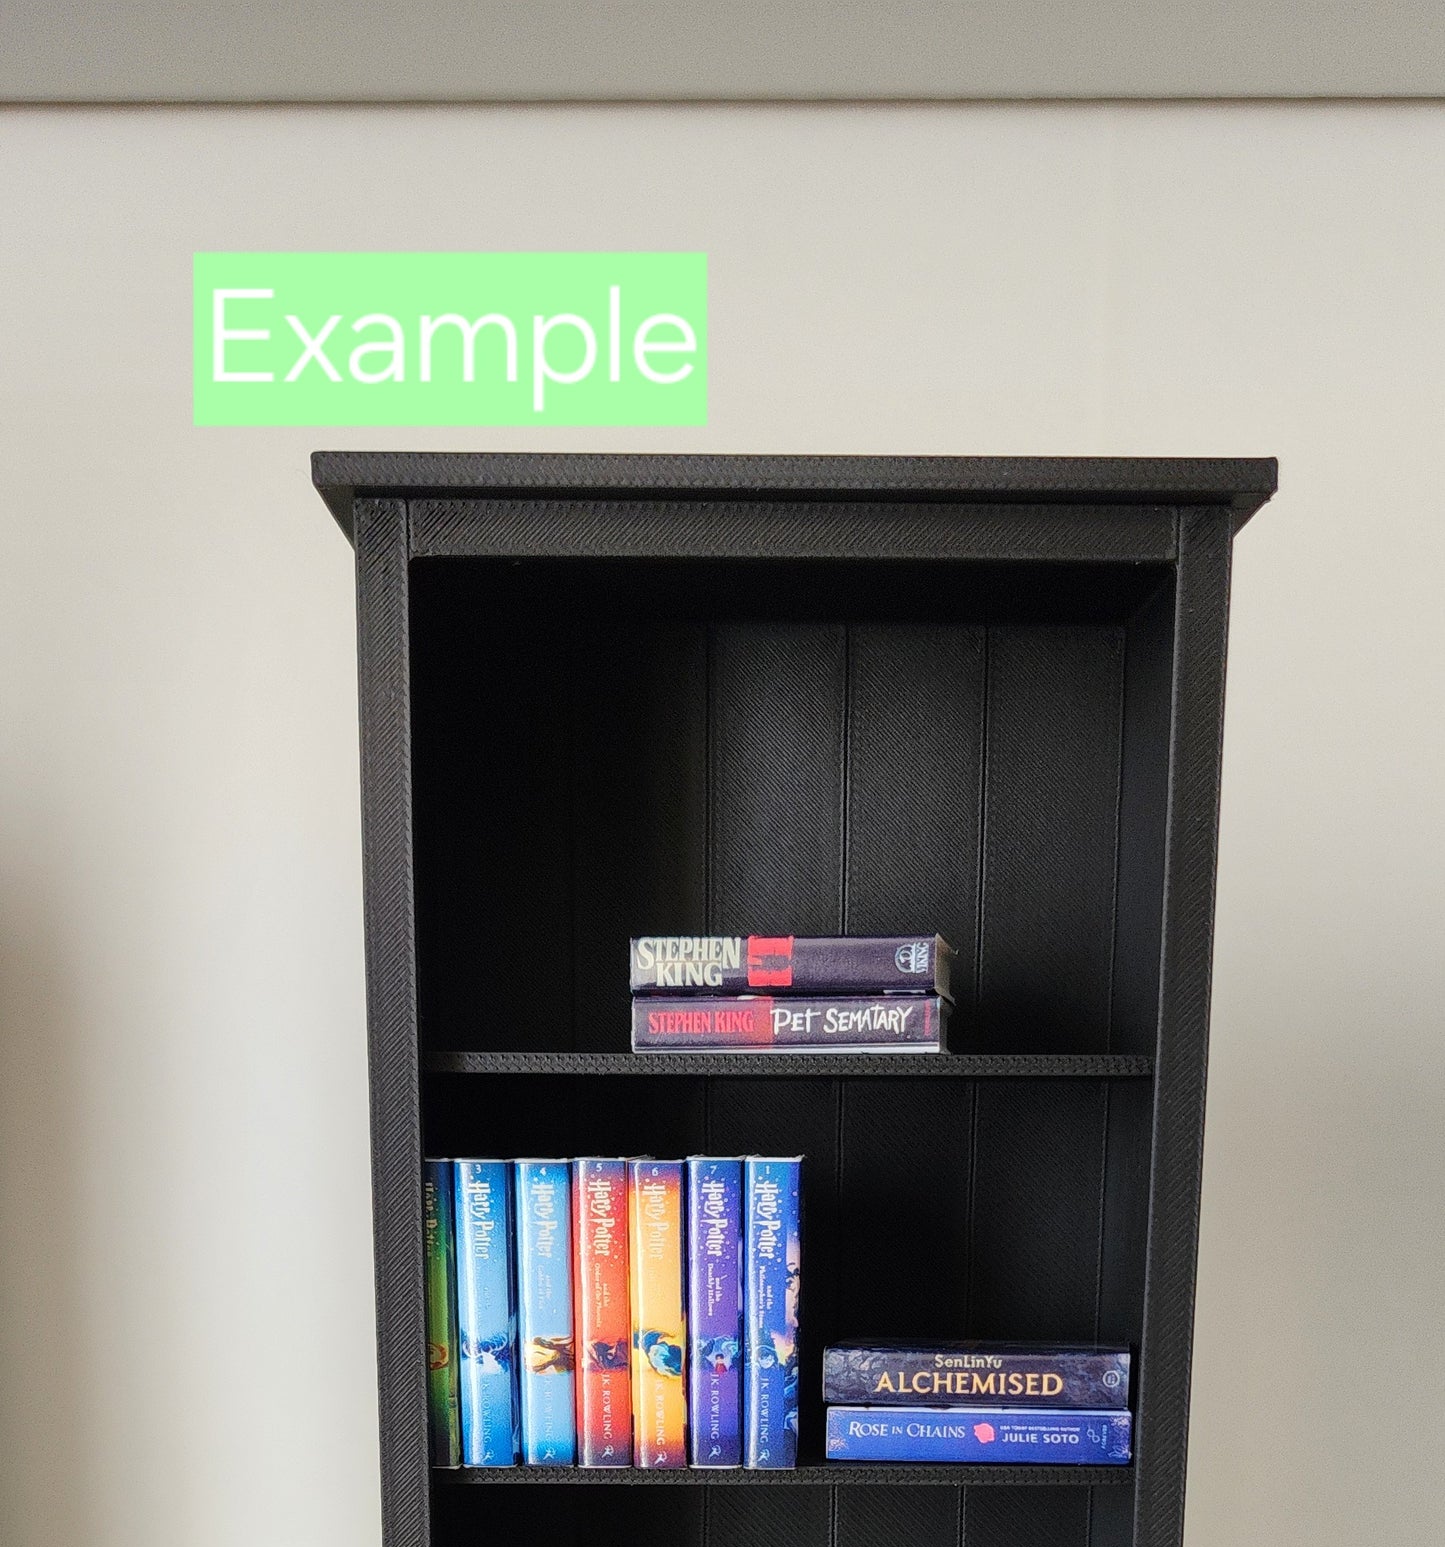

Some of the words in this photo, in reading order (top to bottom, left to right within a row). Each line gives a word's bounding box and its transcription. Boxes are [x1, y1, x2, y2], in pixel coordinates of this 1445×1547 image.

[637, 936, 741, 970] STEPHEN
[656, 960, 723, 986] KING
[649, 1010, 711, 1035] STEPHEN
[714, 1010, 754, 1034] KING
[823, 1004, 914, 1035] SEMATARY
[475, 1164, 482, 1175] 3
[595, 1163, 603, 1173] 5
[651, 1167, 659, 1177] 6
[709, 1164, 717, 1175] 7
[765, 1165, 770, 1175] 1
[467, 1181, 492, 1220] Harry
[531, 1183, 556, 1219] Harry
[588, 1179, 612, 1217] Harry
[642, 1183, 667, 1220] Harry
[700, 1180, 725, 1218] Harry
[754, 1180, 779, 1219] Harry
[472, 1220, 496, 1260] Potter
[535, 1220, 559, 1259] Potter
[589, 1217, 616, 1257] Potter
[647, 1222, 670, 1260] Potter
[700, 1218, 728, 1257] Potter
[753, 1220, 781, 1259] Potter
[873, 1371, 1065, 1396] ALCHEMISED
[602, 1390, 613, 1440] ROWLING
[655, 1395, 666, 1446] ROWLING
[709, 1390, 720, 1440] ROWLING
[759, 1394, 770, 1444] ROWLING
[848, 1420, 889, 1438] ROSE
[906, 1422, 966, 1438] CHAINS
[1002, 1432, 1038, 1443] JULIE
[1043, 1433, 1080, 1444] SOTO
